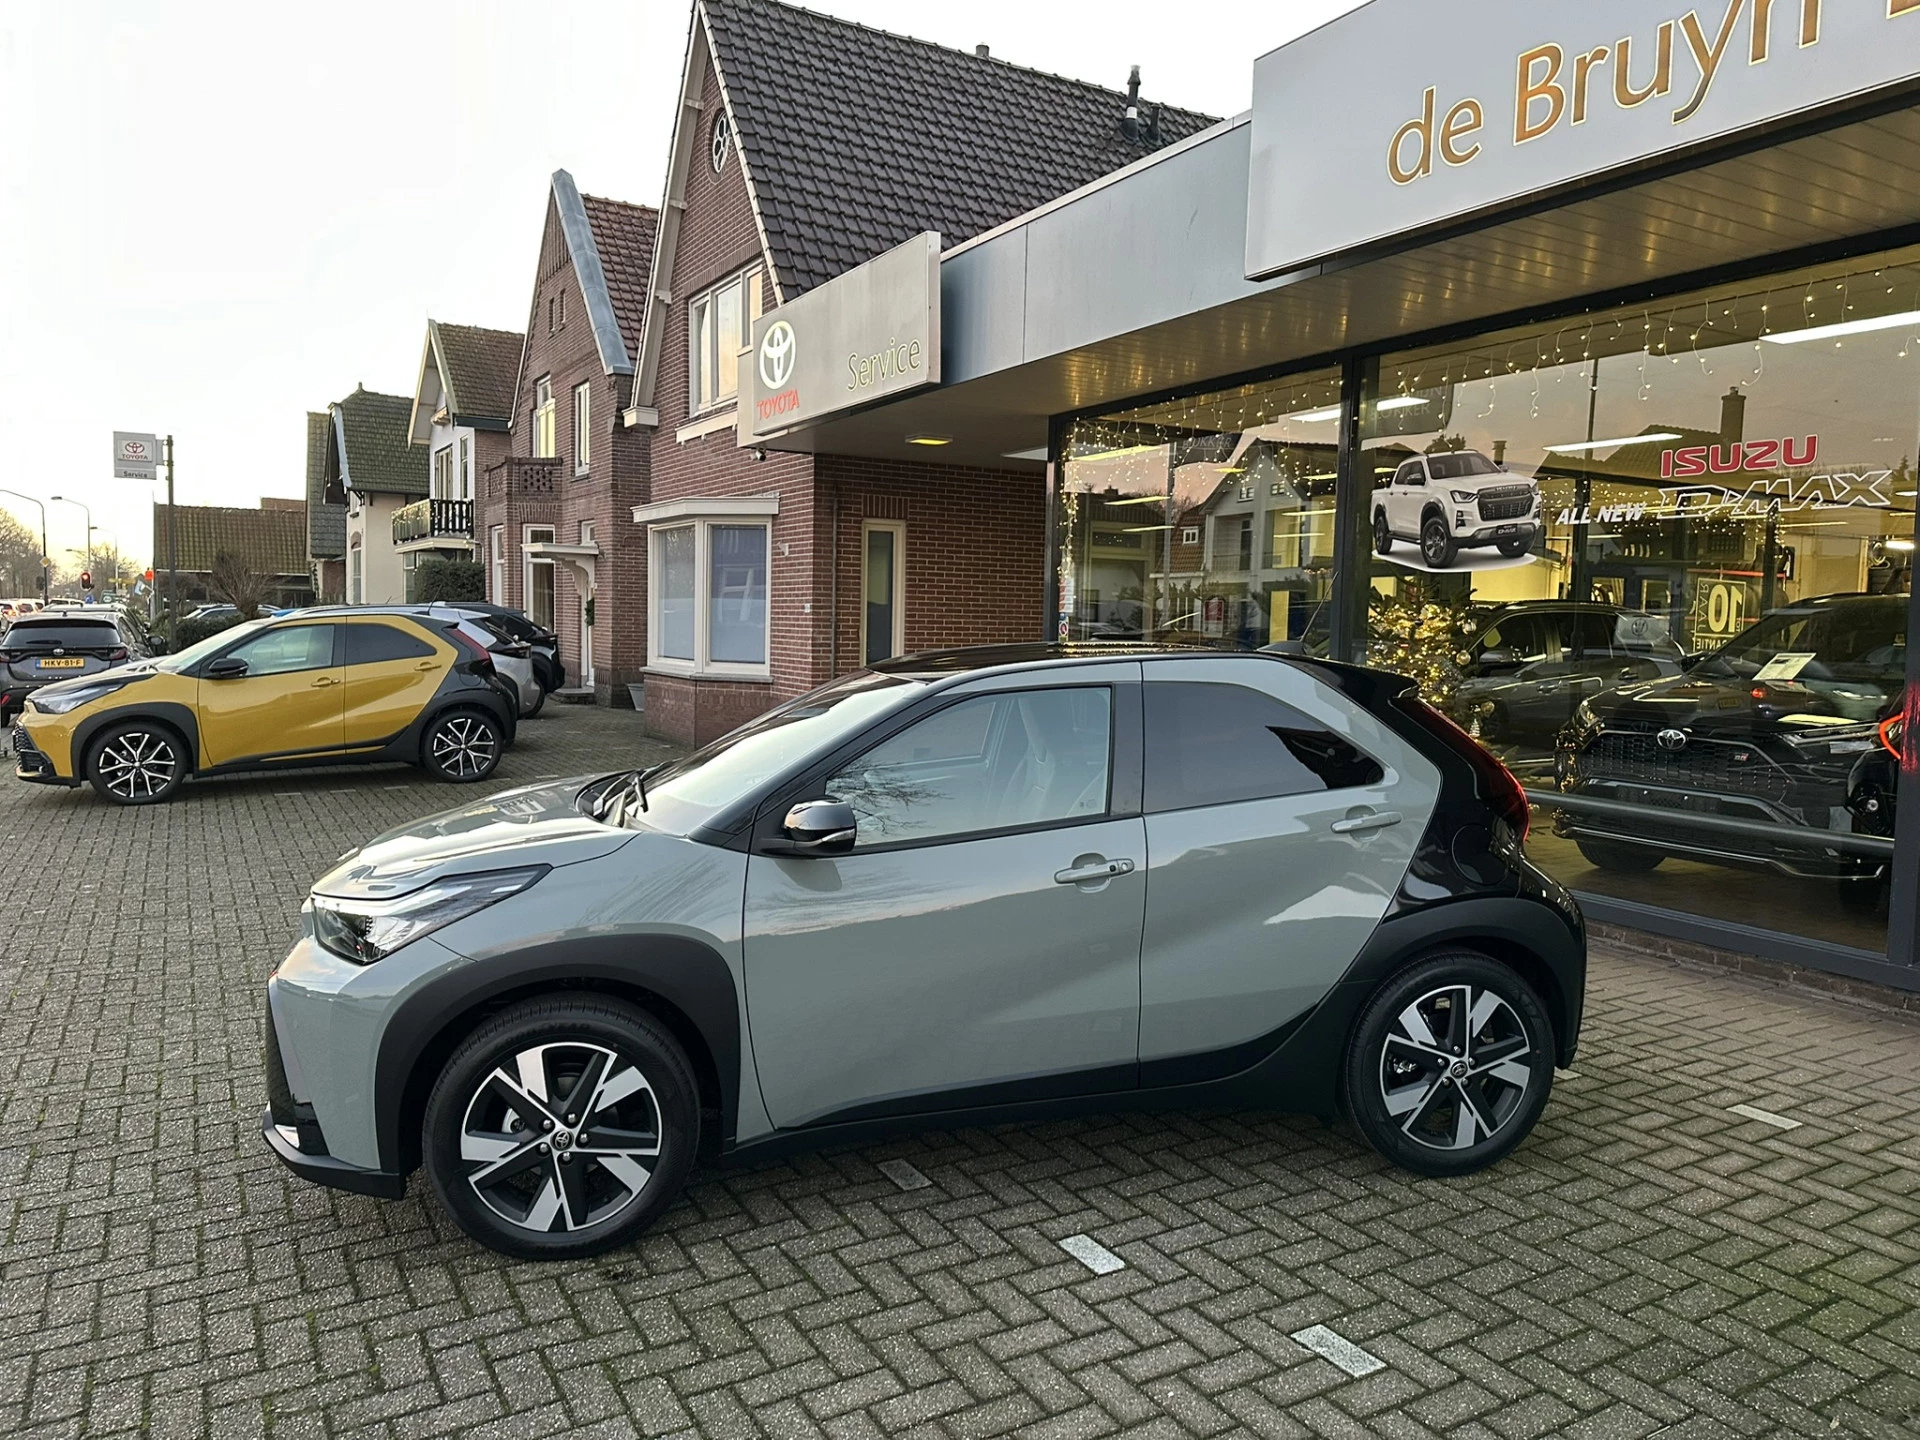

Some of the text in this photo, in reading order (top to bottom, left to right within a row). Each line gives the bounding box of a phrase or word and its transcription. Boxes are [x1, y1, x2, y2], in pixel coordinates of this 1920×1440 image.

[1387, 85, 1484, 186] de
[847, 336, 922, 392] Service
[756, 388, 800, 421] TOYOTA
[123, 470, 148, 478] Service
[1660, 434, 1819, 478] ISUZU
[1555, 506, 1592, 526] ALL
[1596, 502, 1647, 524] NEW
